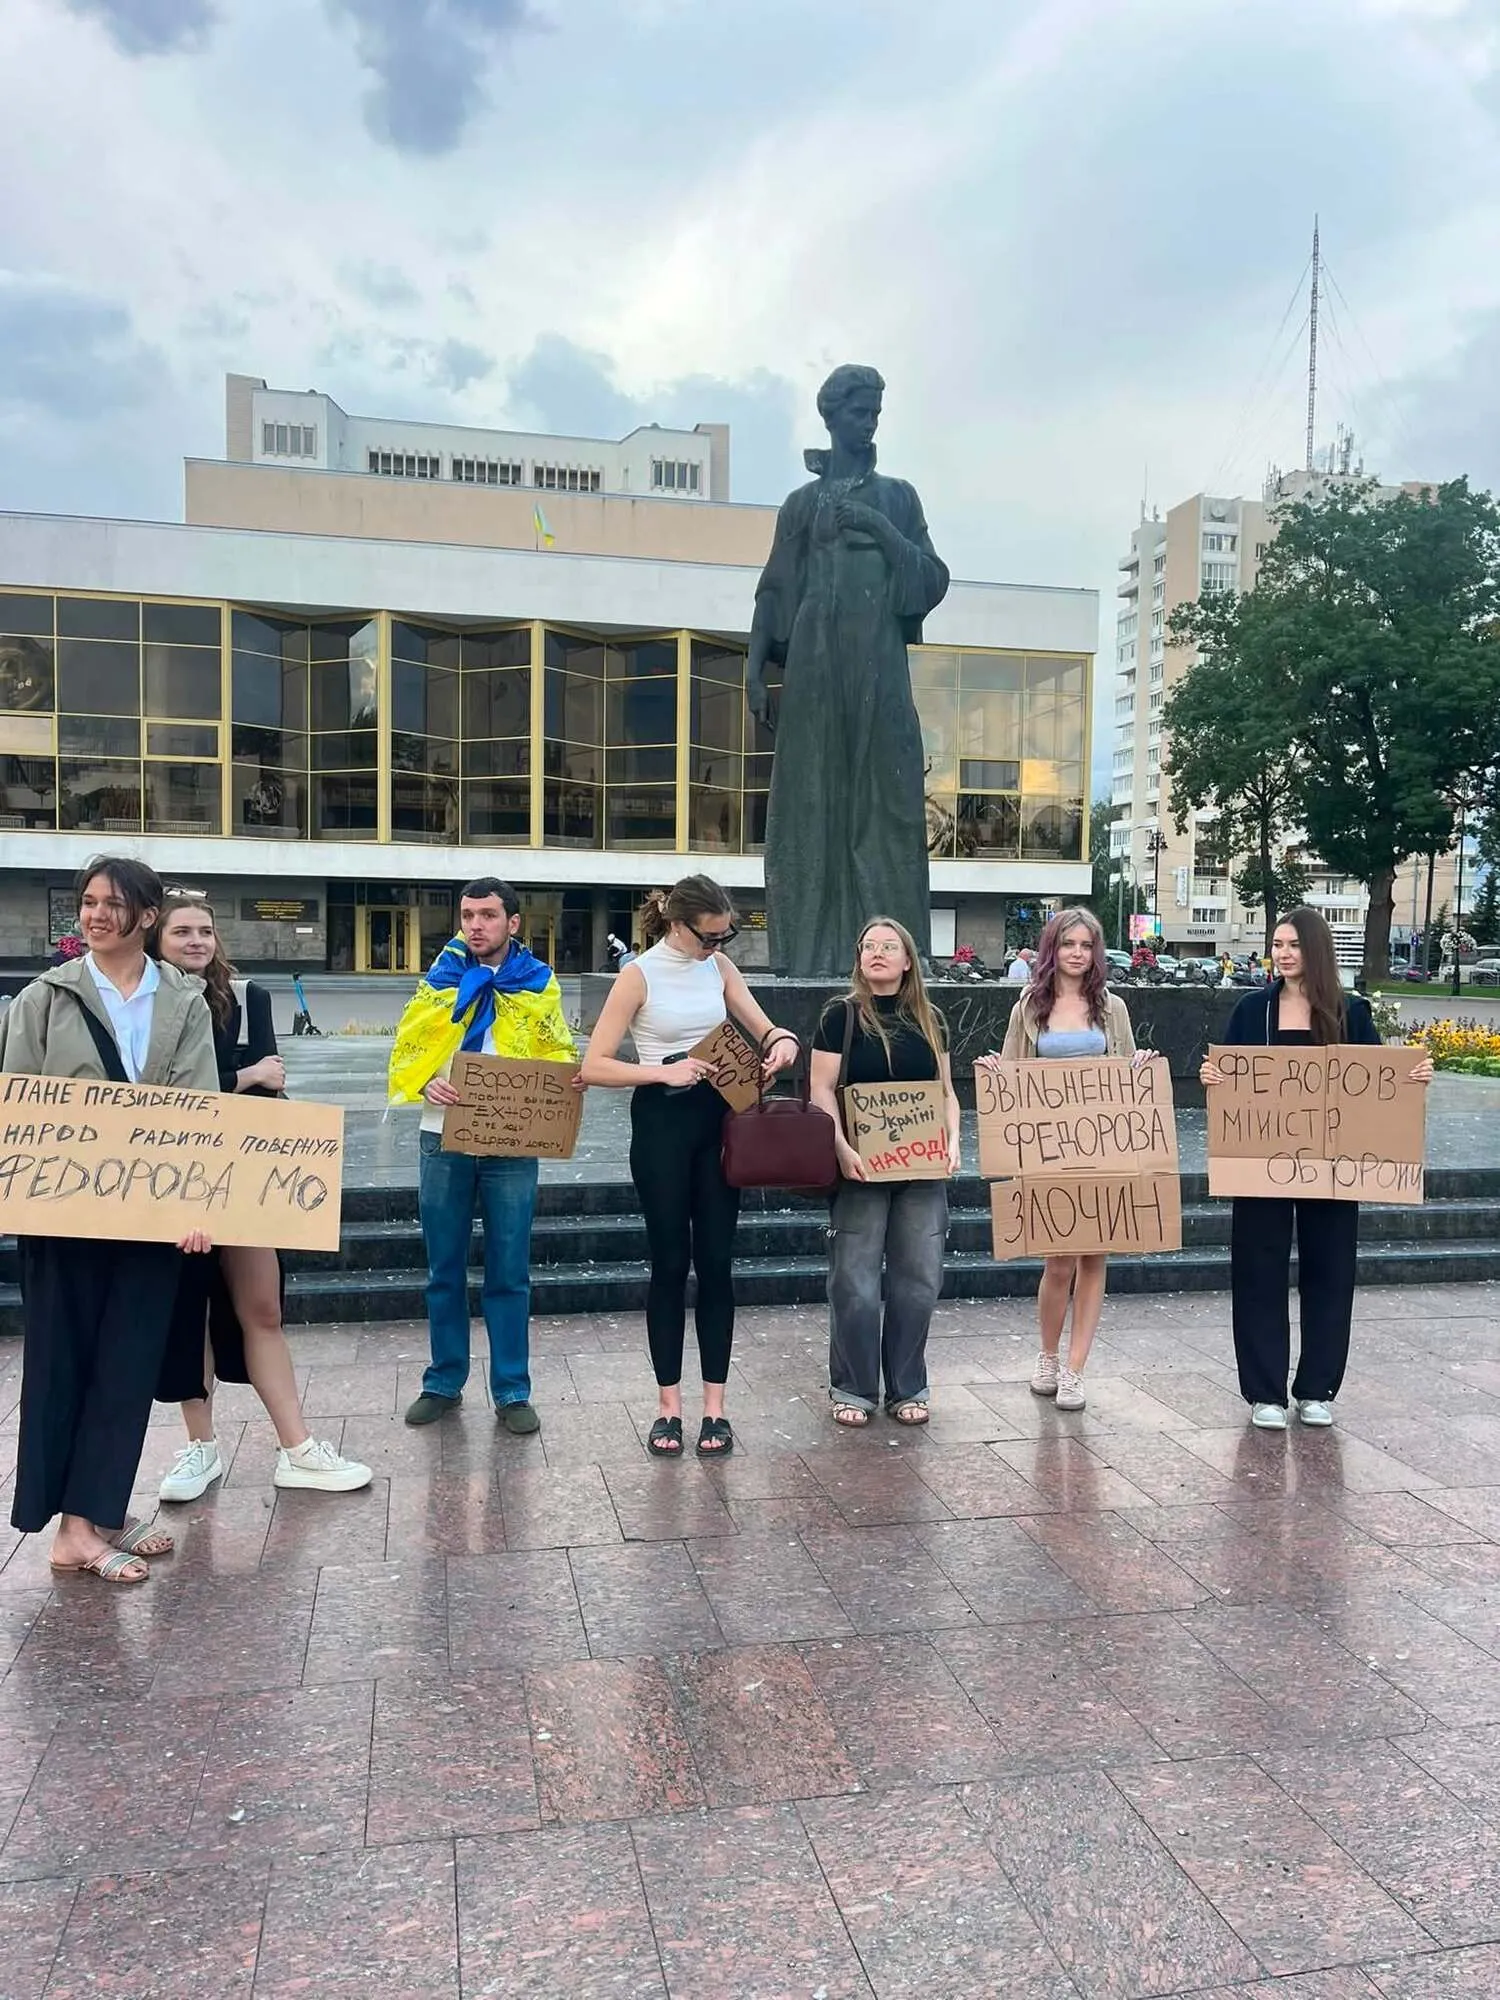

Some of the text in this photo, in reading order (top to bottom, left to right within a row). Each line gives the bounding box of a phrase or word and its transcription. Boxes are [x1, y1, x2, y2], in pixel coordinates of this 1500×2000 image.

[3, 1077, 77, 1105] ПАНЕ
[868, 1126, 949, 1173] НАРОД!
[1003, 1107, 1169, 1169] ФЕДОРОВА
[258, 1164, 329, 1212] МО
[1004, 1182, 1164, 1244] ЗЛОЧИН
